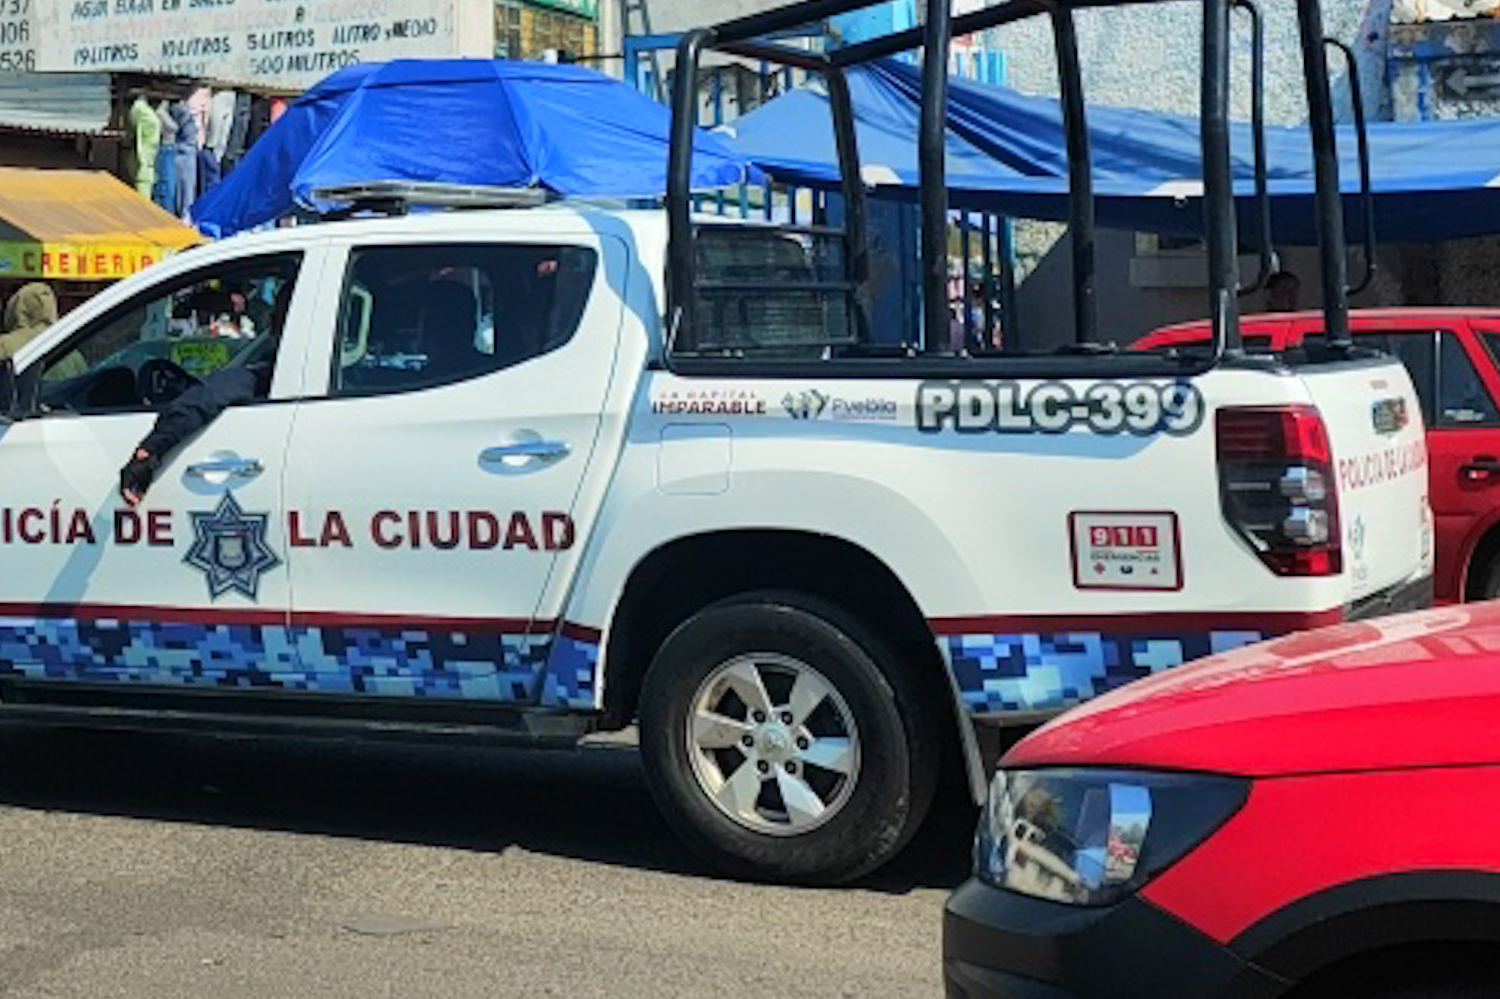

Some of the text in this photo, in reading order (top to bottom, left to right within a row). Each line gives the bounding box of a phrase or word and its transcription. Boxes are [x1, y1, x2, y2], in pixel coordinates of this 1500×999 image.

[652, 400, 767, 414] IMPARABLE
[918, 382, 1204, 433] PDLC-399
[113, 506, 175, 547] DE
[288, 509, 353, 548] LA
[370, 509, 577, 551] CIUDAD
[1091, 526, 1155, 546] 911
